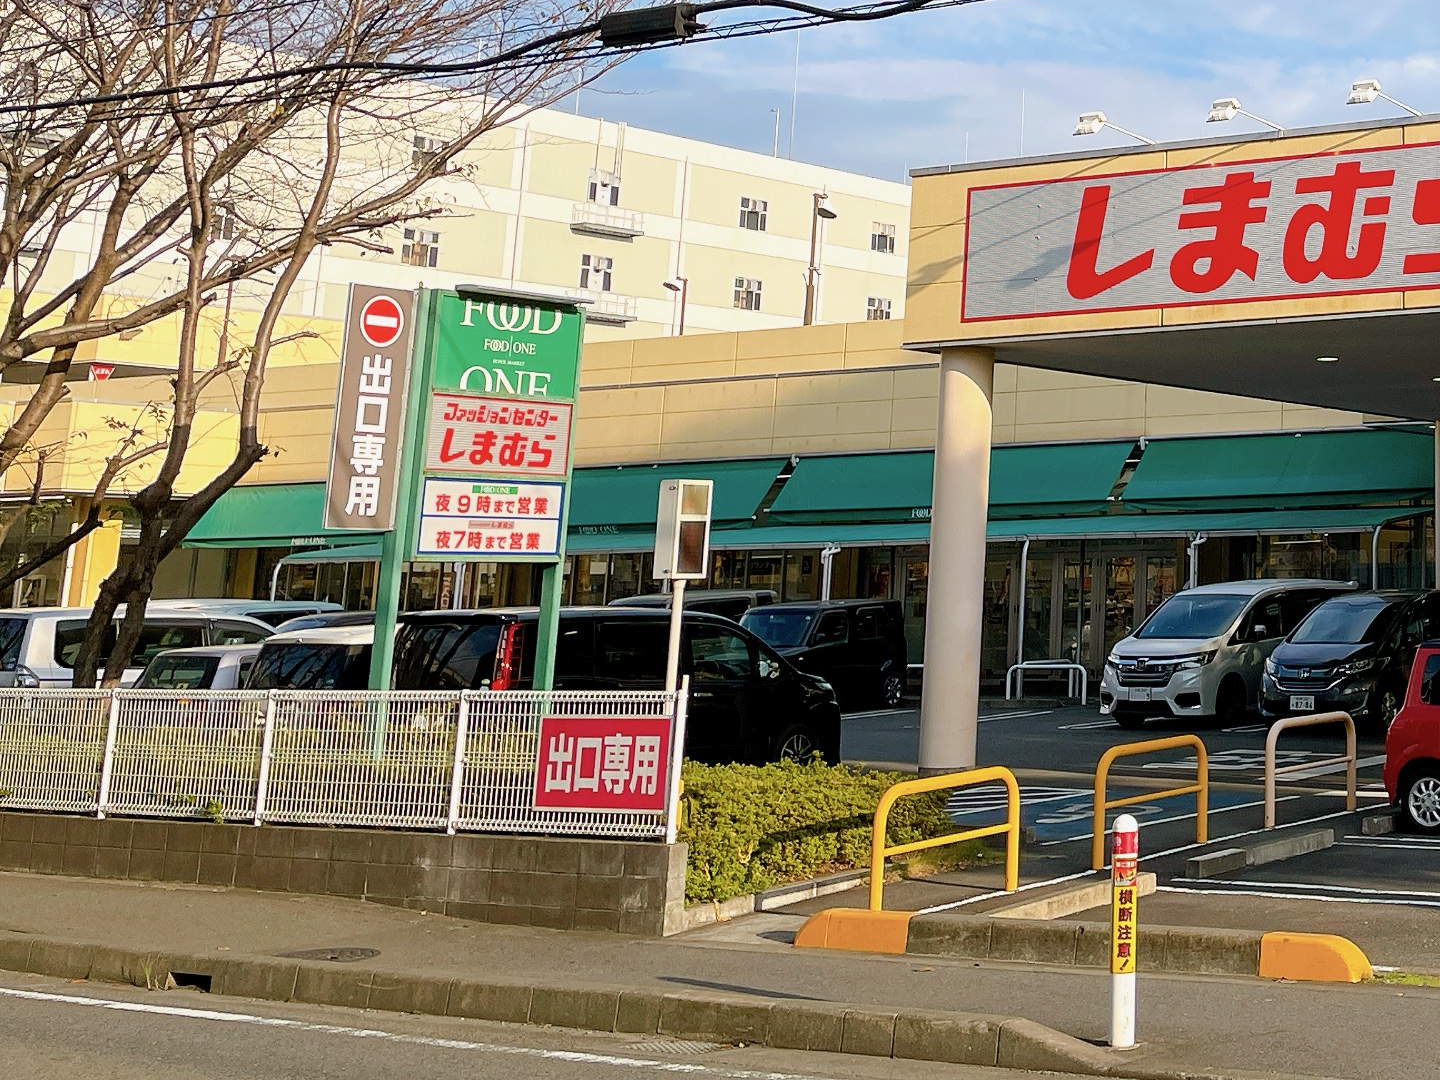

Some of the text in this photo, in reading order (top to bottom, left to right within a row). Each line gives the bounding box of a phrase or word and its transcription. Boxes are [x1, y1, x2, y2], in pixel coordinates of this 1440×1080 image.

[459, 298, 563, 334] FOOD
[484, 338, 536, 355] FOOD ONE
[459, 366, 551, 396] ONE
[444, 403, 558, 427] ファッションセンター
[344, 354, 394, 517] 出口専用
[440, 428, 556, 468] しまむら
[544, 732, 661, 796] 出口専用
